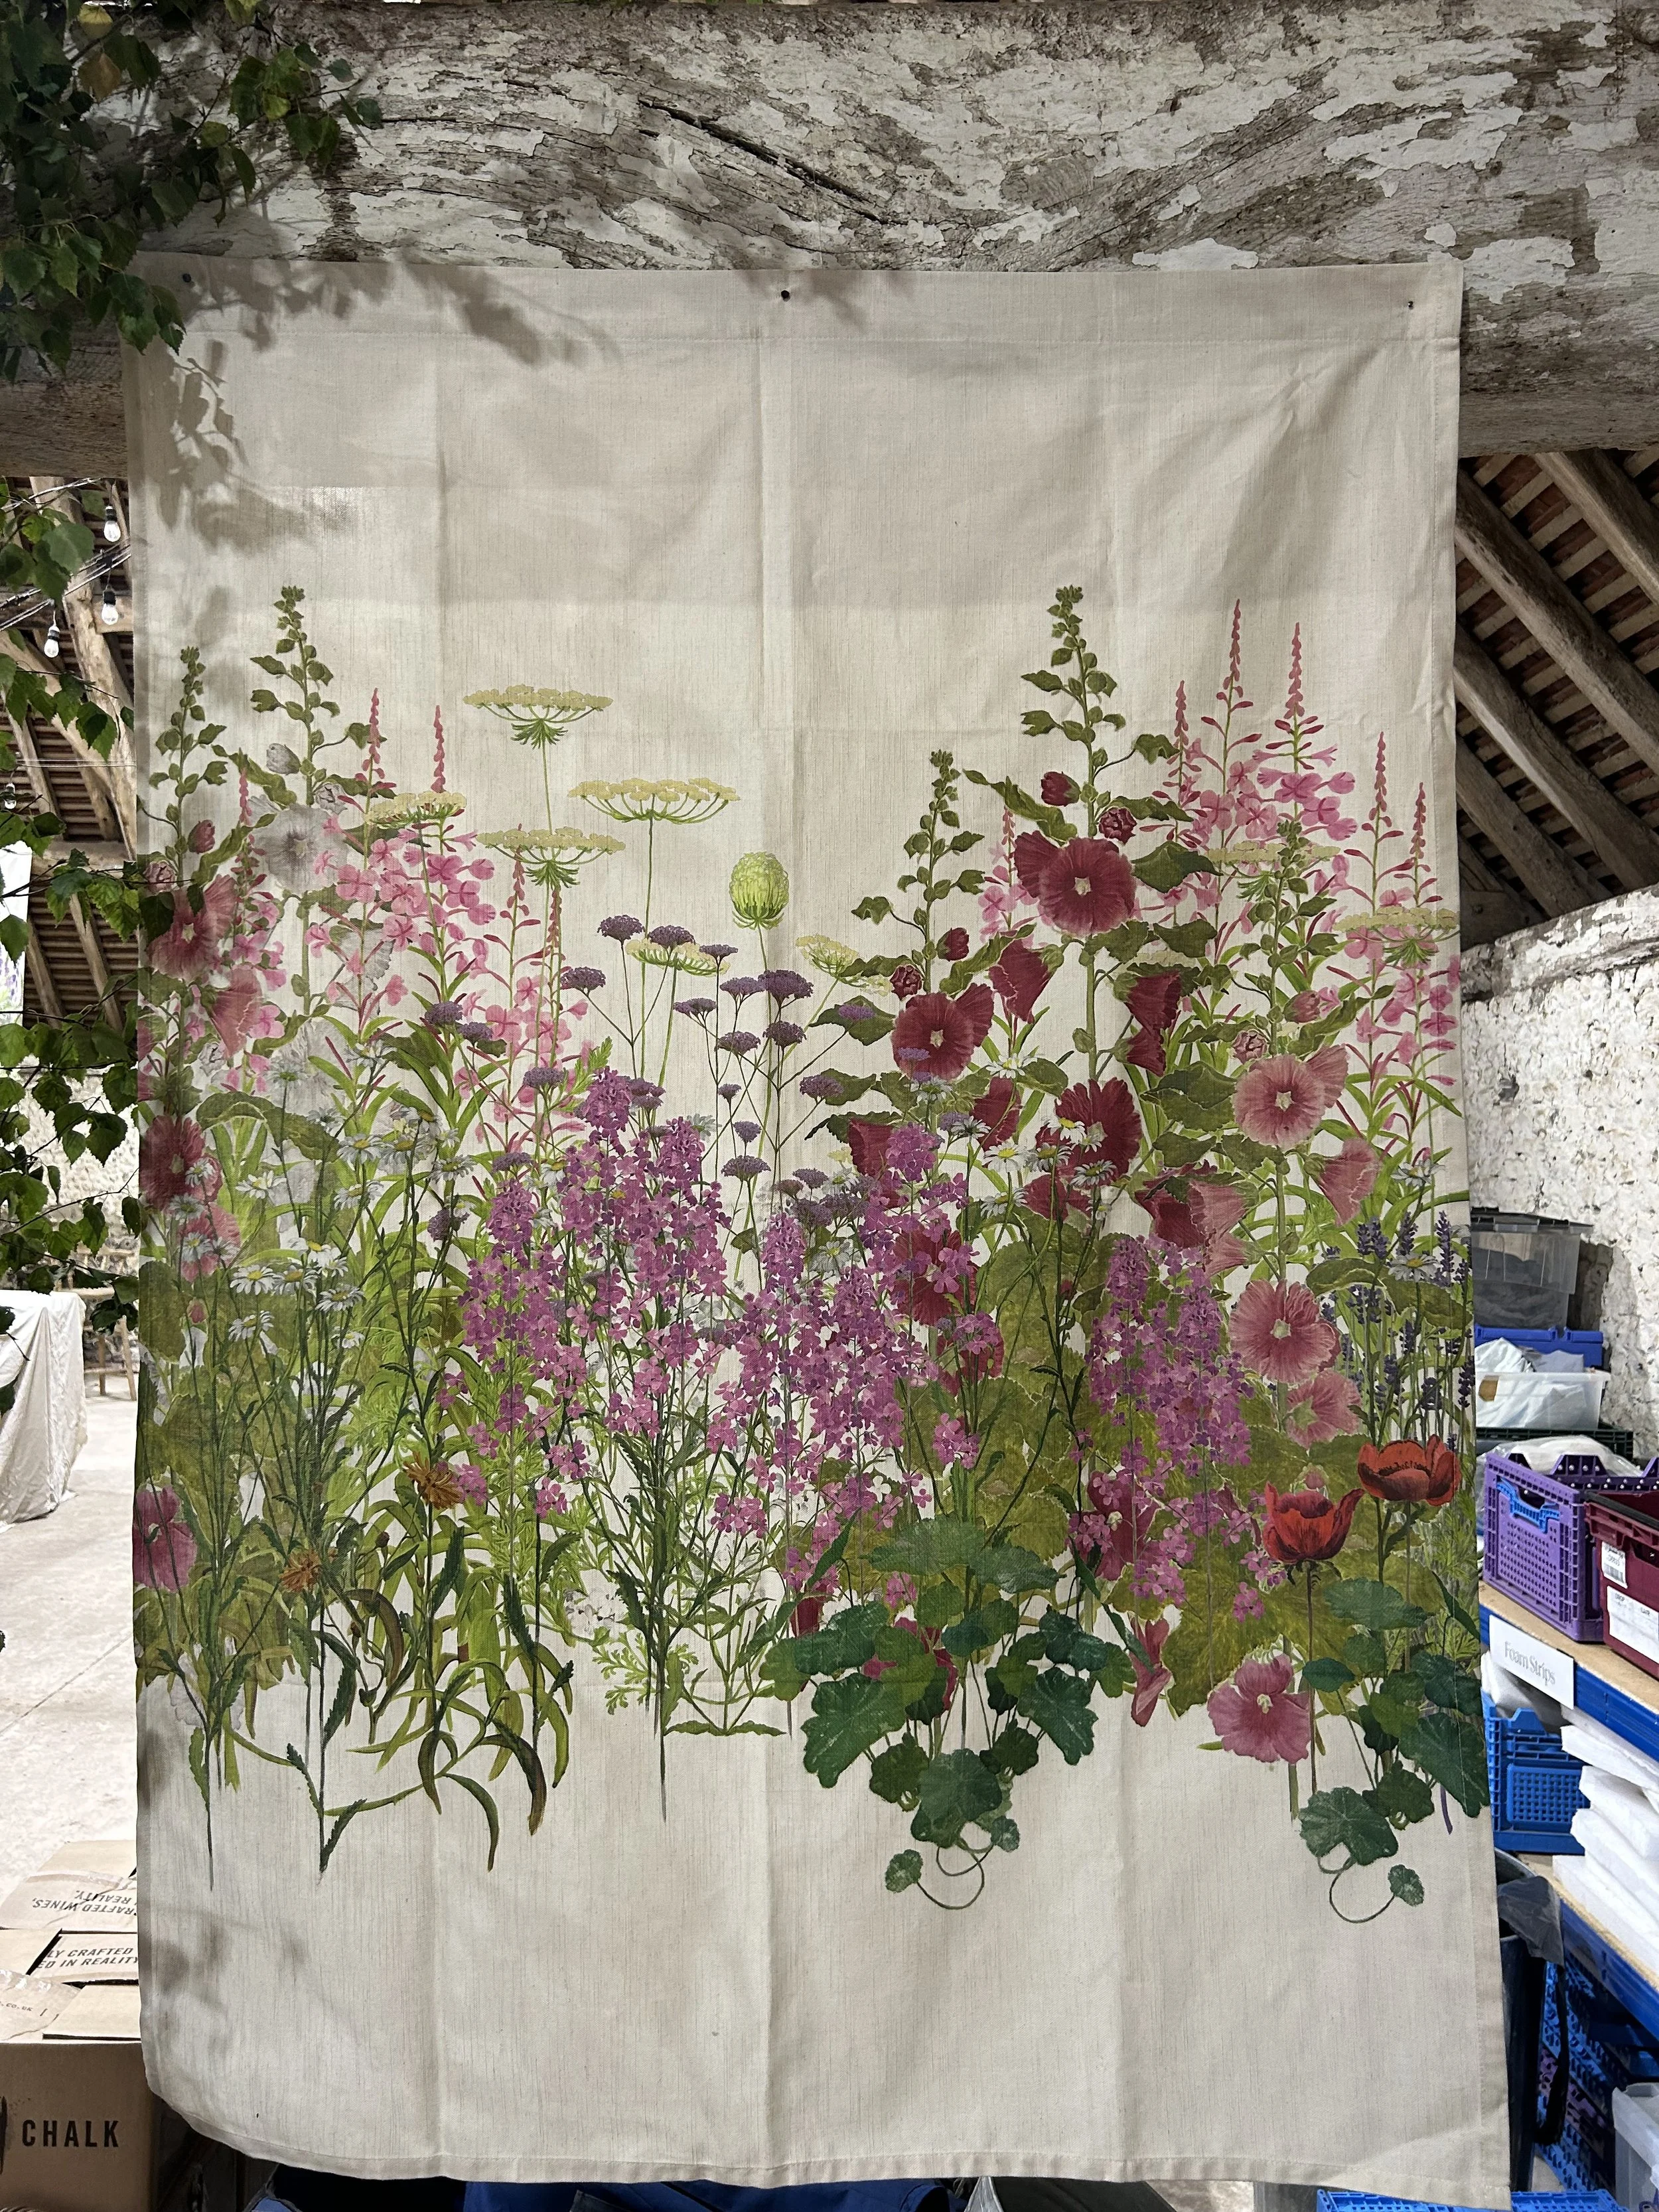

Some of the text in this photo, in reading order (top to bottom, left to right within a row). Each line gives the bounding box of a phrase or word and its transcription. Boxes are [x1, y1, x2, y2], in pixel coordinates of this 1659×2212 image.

[1504, 1641, 1555, 1686] Foam Strips
[82, 1903, 137, 1916] RAFTED
[68, 1947, 134, 1957] CRAFTED
[60, 1959, 78, 1968] IN
[22, 2119, 119, 2148] CHALK
